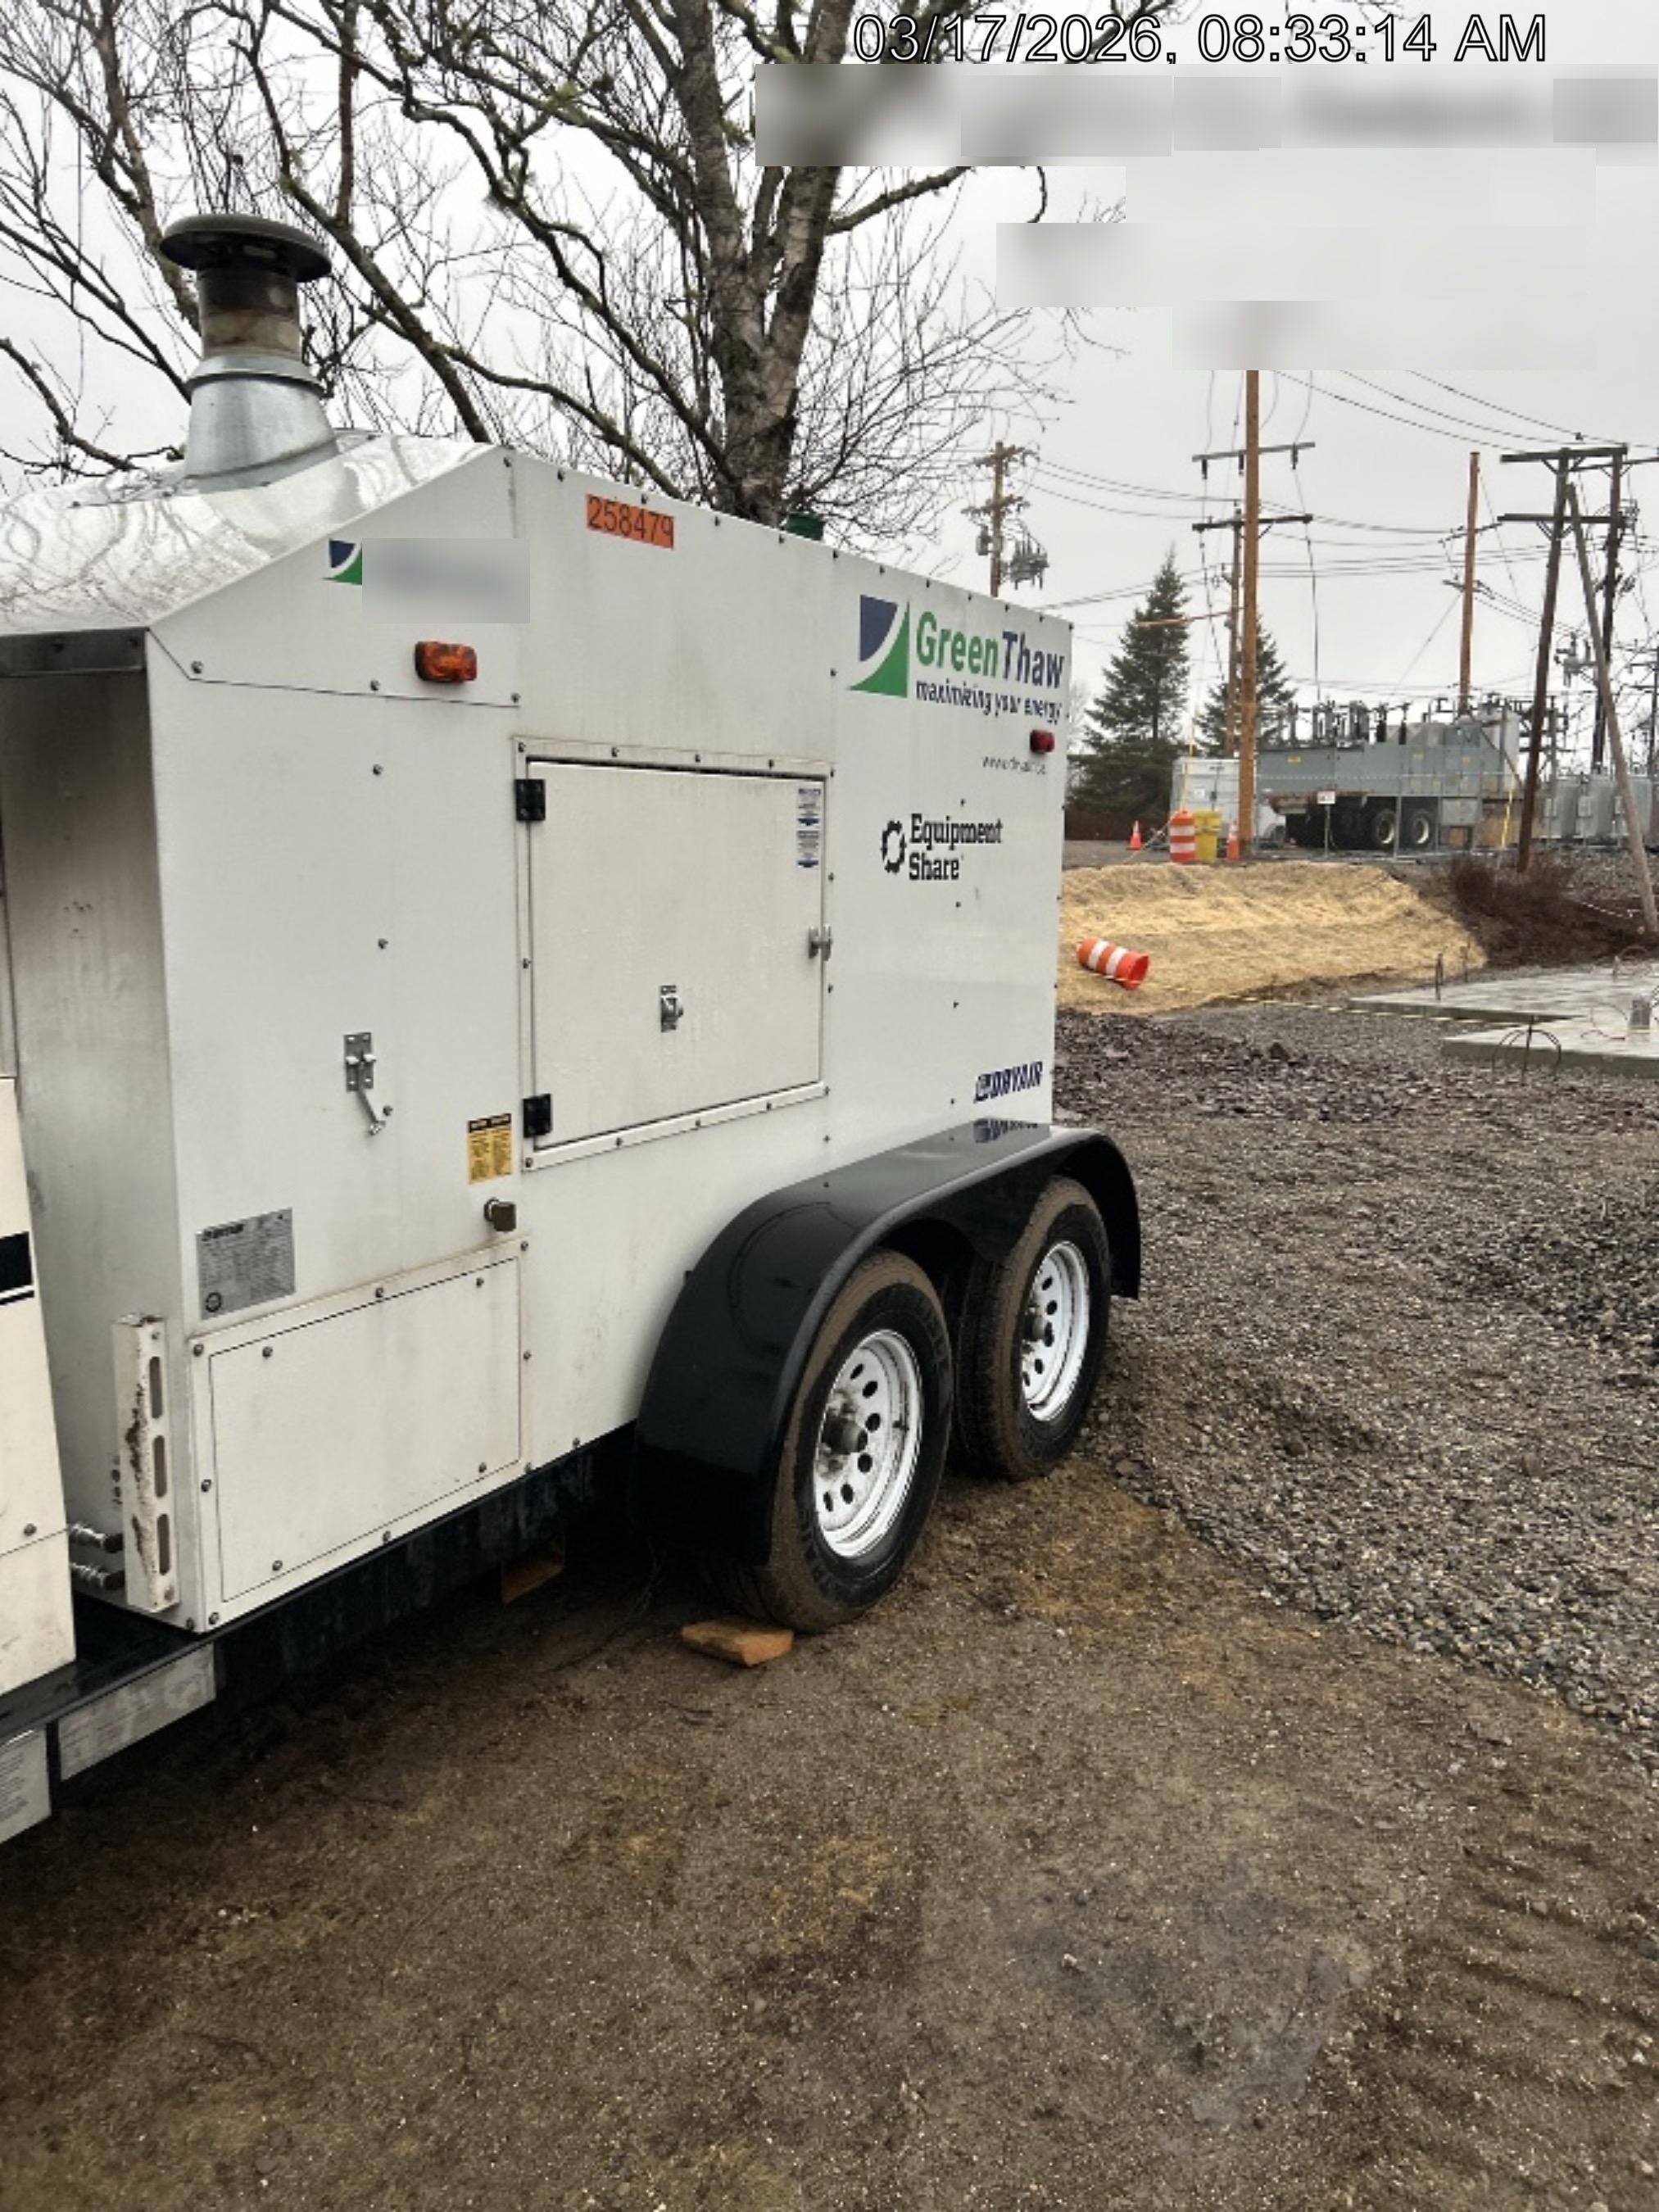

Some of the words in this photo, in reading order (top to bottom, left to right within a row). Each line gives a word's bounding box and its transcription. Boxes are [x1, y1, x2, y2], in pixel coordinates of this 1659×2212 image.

[587, 495, 673, 548] 258479
[916, 678, 991, 716] maximizing
[995, 692, 1022, 718] your
[1024, 697, 1063, 726] energy
[910, 813, 1003, 850] Equipment
[909, 852, 959, 880] Share
